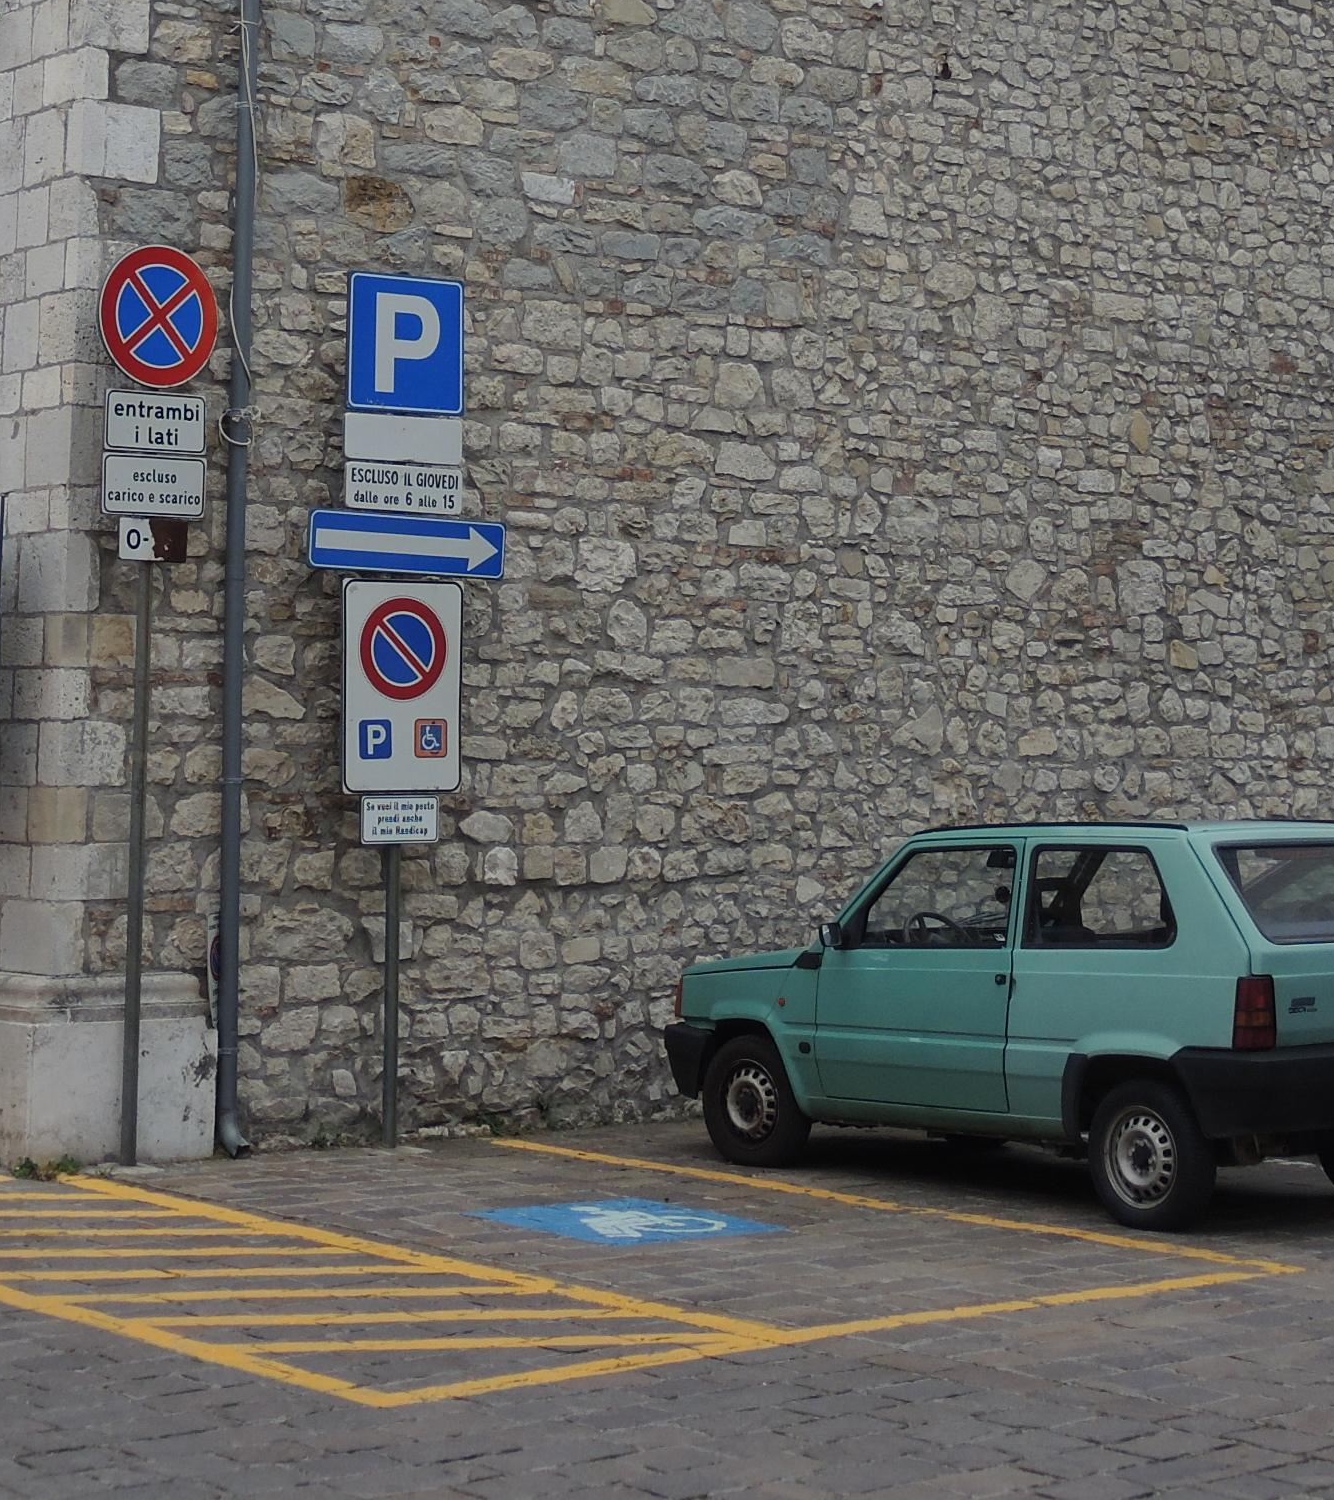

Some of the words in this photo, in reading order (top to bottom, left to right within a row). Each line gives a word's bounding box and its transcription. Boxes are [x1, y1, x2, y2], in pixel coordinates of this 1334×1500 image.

[375, 291, 441, 393] P
[114, 401, 199, 422] entrambi
[135, 425, 140, 443] i
[148, 426, 179, 446] lati
[133, 468, 177, 484] escluso
[351, 467, 399, 486] ESCLUSO
[404, 472, 413, 487] IL
[416, 472, 459, 490] GIOVEDI
[108, 487, 144, 503] carico
[148, 492, 155, 503] e
[159, 490, 201, 506] scarico
[353, 490, 379, 504] dalle
[383, 495, 400, 505] ore
[405, 492, 413, 506] 6
[418, 495, 437, 508] alle
[442, 494, 455, 509] 15
[367, 724, 387, 755] P
[366, 802, 375, 811] Se
